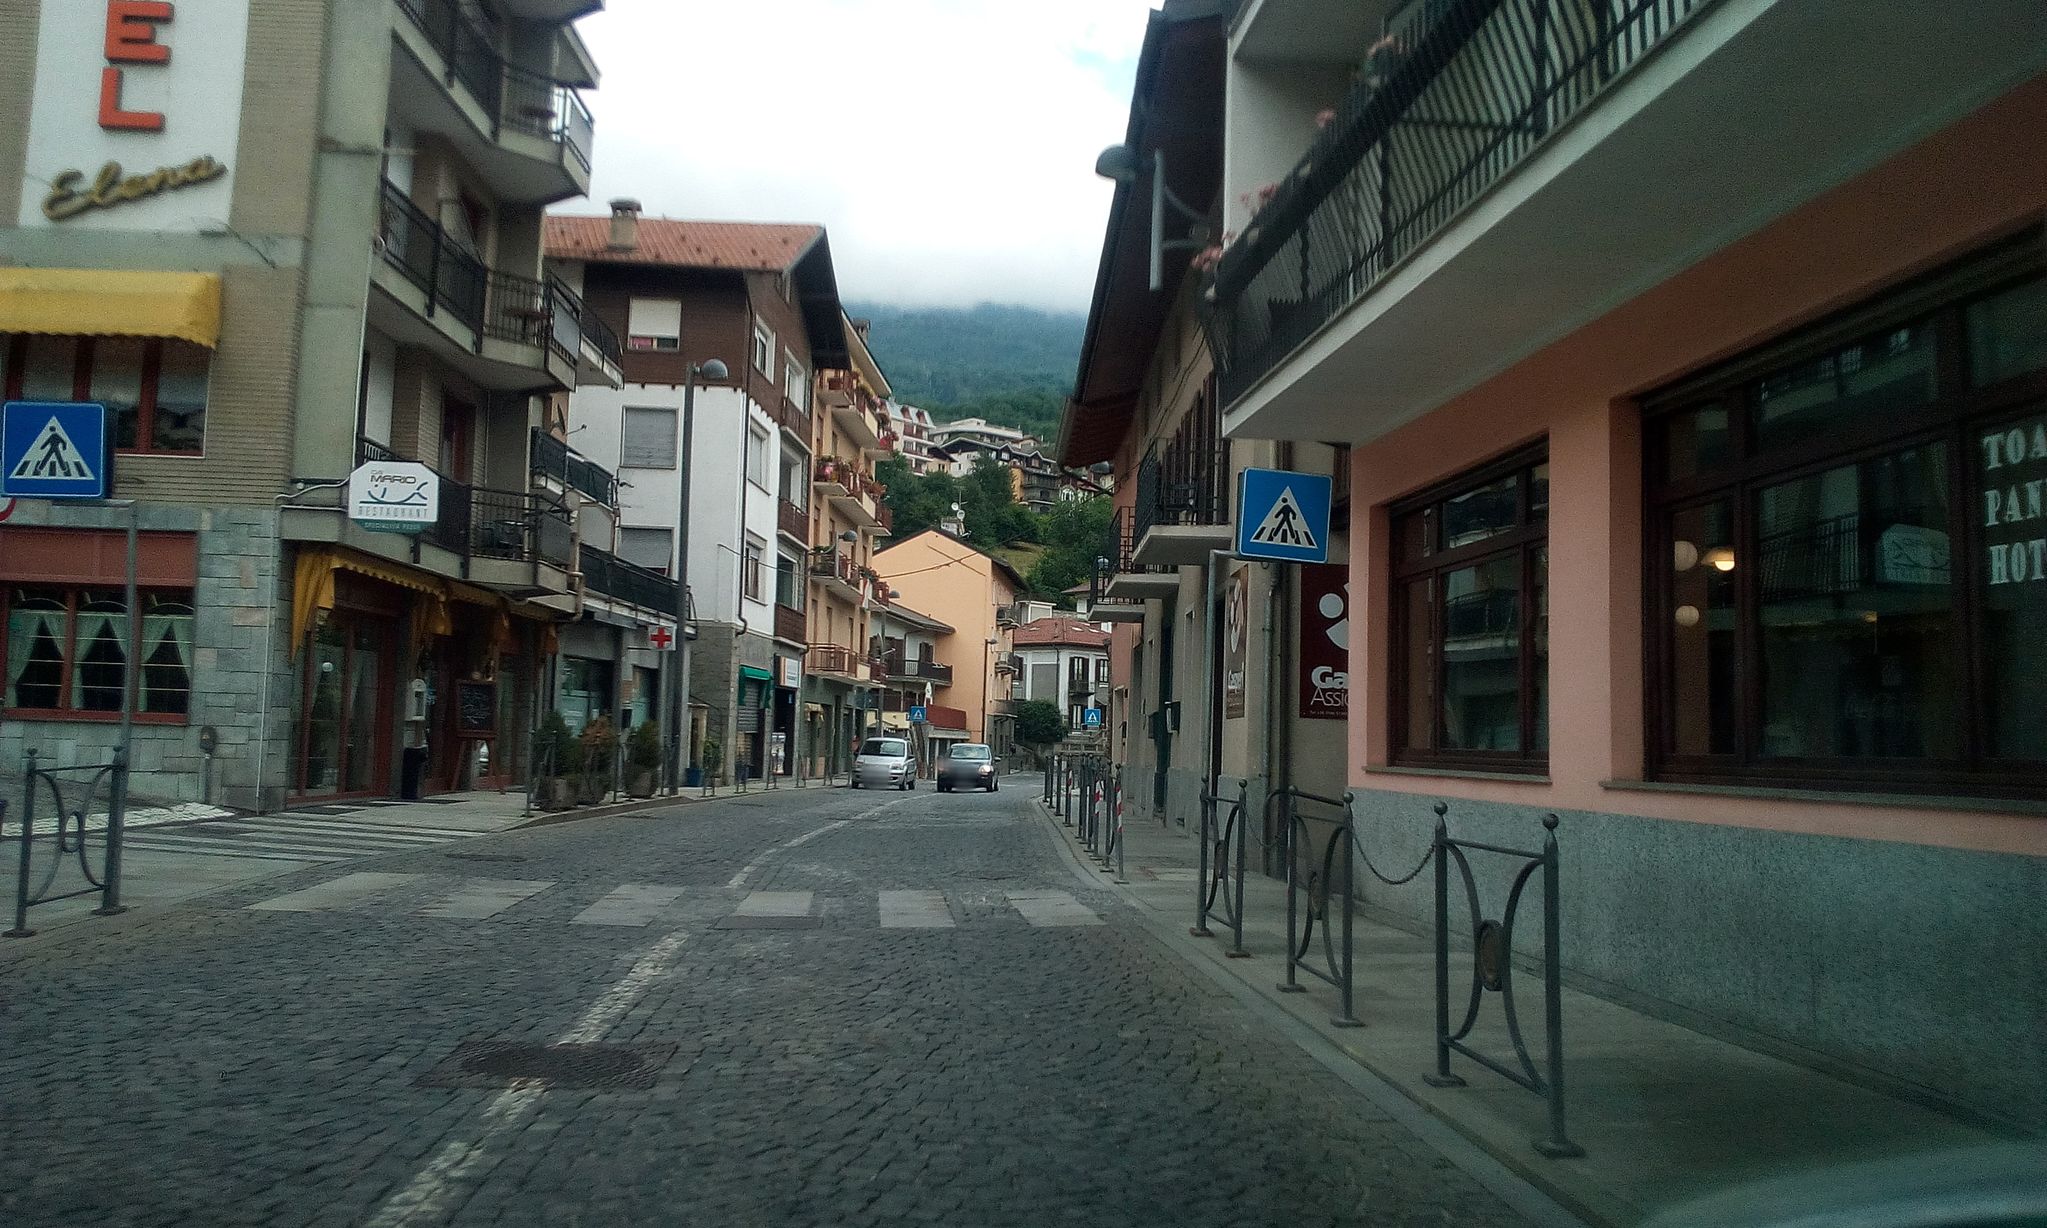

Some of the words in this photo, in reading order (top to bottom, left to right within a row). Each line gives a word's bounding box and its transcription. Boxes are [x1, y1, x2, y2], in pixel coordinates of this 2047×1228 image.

[42, 154, 228, 220] Elena
[1982, 424, 2047, 470] TOA
[370, 474, 417, 484] MARIO
[358, 506, 428, 517] RESTAURANT
[1989, 538, 2047, 585] HOT
